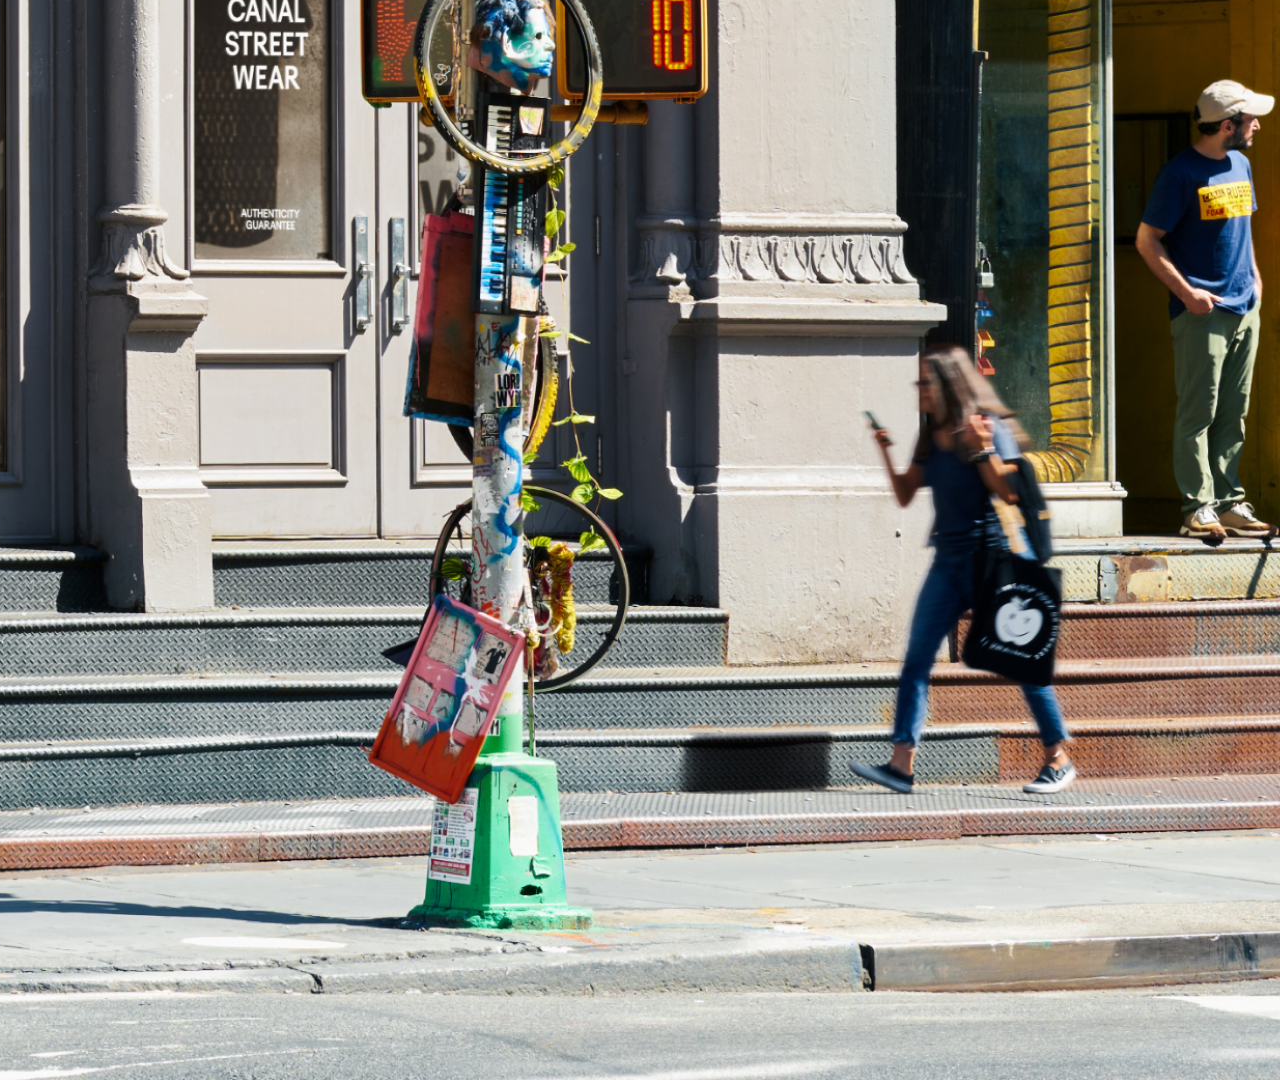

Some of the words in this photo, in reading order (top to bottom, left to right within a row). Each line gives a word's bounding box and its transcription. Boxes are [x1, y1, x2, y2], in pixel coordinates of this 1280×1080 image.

[225, 30, 309, 57] STREET
[232, 64, 301, 90] WEAR
[241, 208, 300, 219] AUTHENTICITY
[245, 219, 296, 230] GUARANTEE
